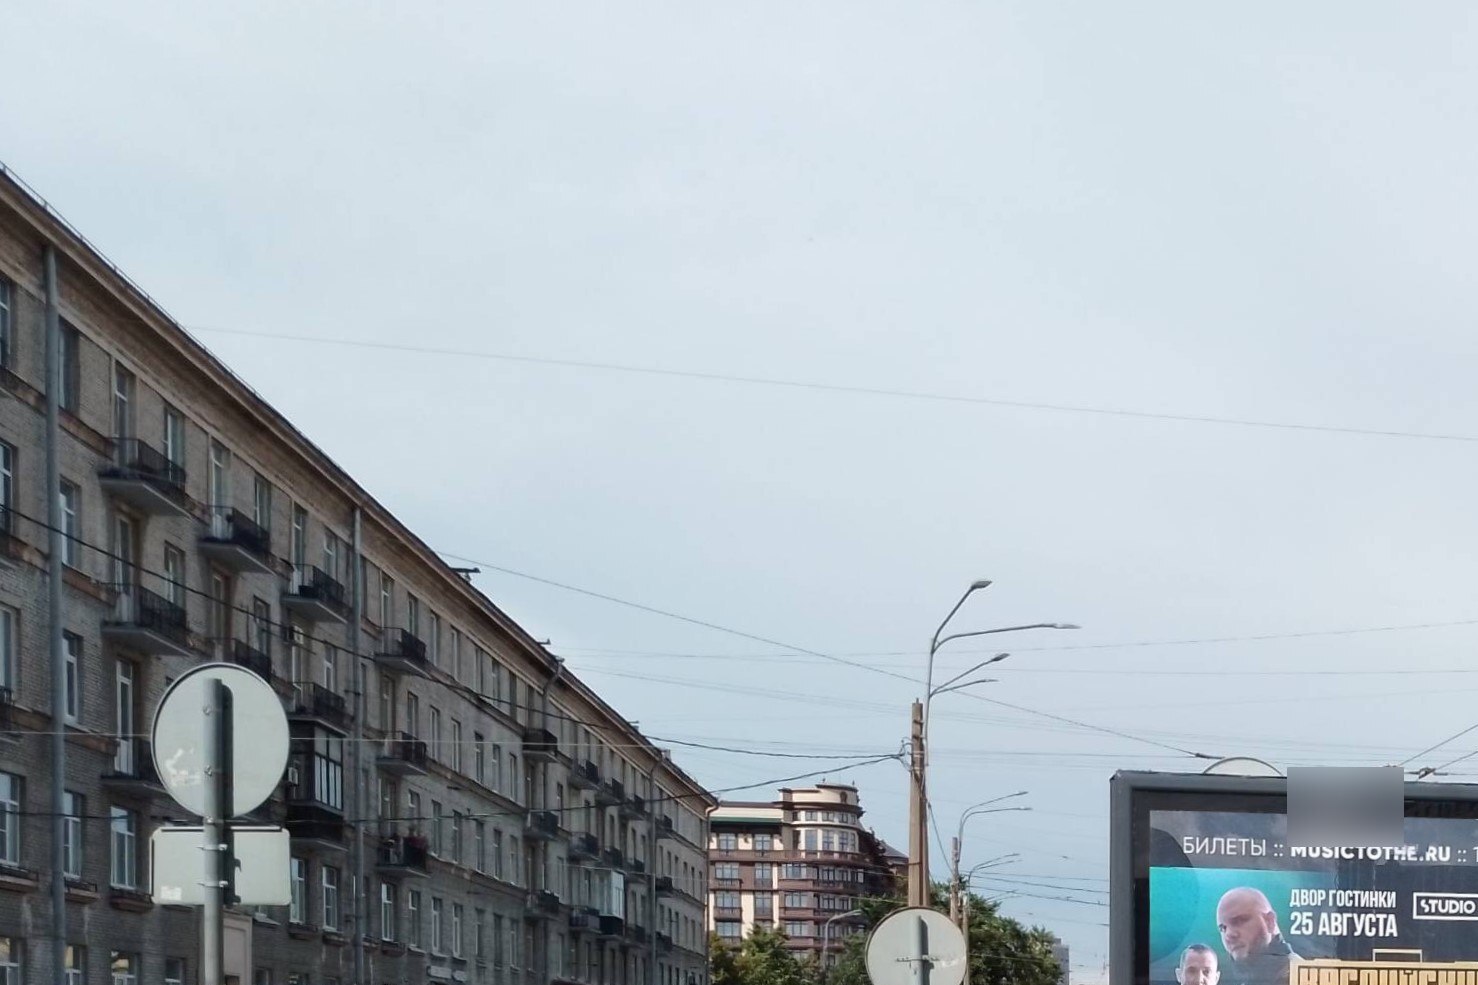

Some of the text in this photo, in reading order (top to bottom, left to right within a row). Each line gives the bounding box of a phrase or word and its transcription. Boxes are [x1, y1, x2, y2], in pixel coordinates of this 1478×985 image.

[1182, 836, 1266, 857] БИЛЕТЫ
[1289, 888, 1397, 909] ДВОР ГОСТИНКИ
[1420, 898, 1476, 915] STUDIO
[1289, 911, 1398, 937] 25 АВГУСТА
